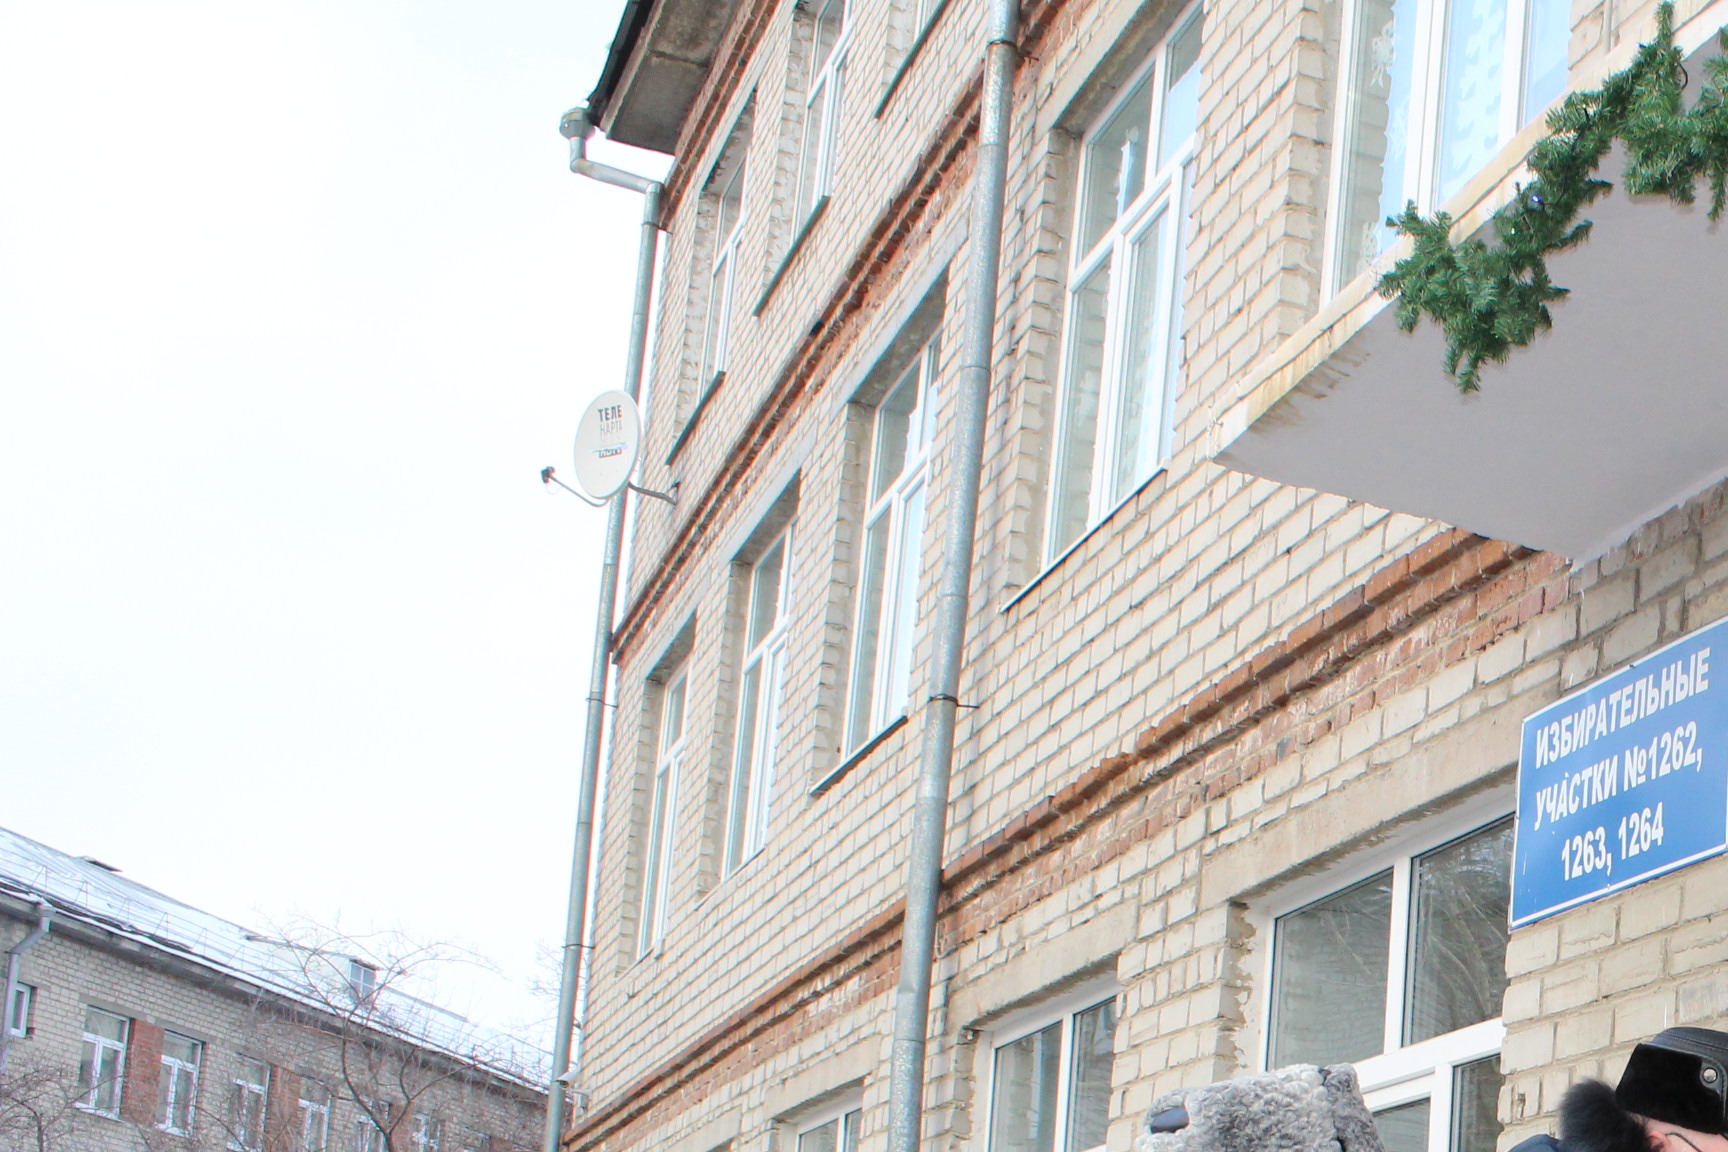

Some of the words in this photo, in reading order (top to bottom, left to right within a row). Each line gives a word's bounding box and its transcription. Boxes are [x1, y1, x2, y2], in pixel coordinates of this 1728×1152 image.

[598, 404, 622, 422] ТЕЛЕ
[600, 420, 623, 436] КАРТА
[1535, 646, 1711, 769] ИЗБИРАТЕЛЬНЫЕ
[1534, 755, 1618, 831] УЧАСТКИ
[1623, 720, 1703, 793] №1262,
[1561, 826, 1613, 881] 1263,
[1618, 801, 1664, 861] 1264
